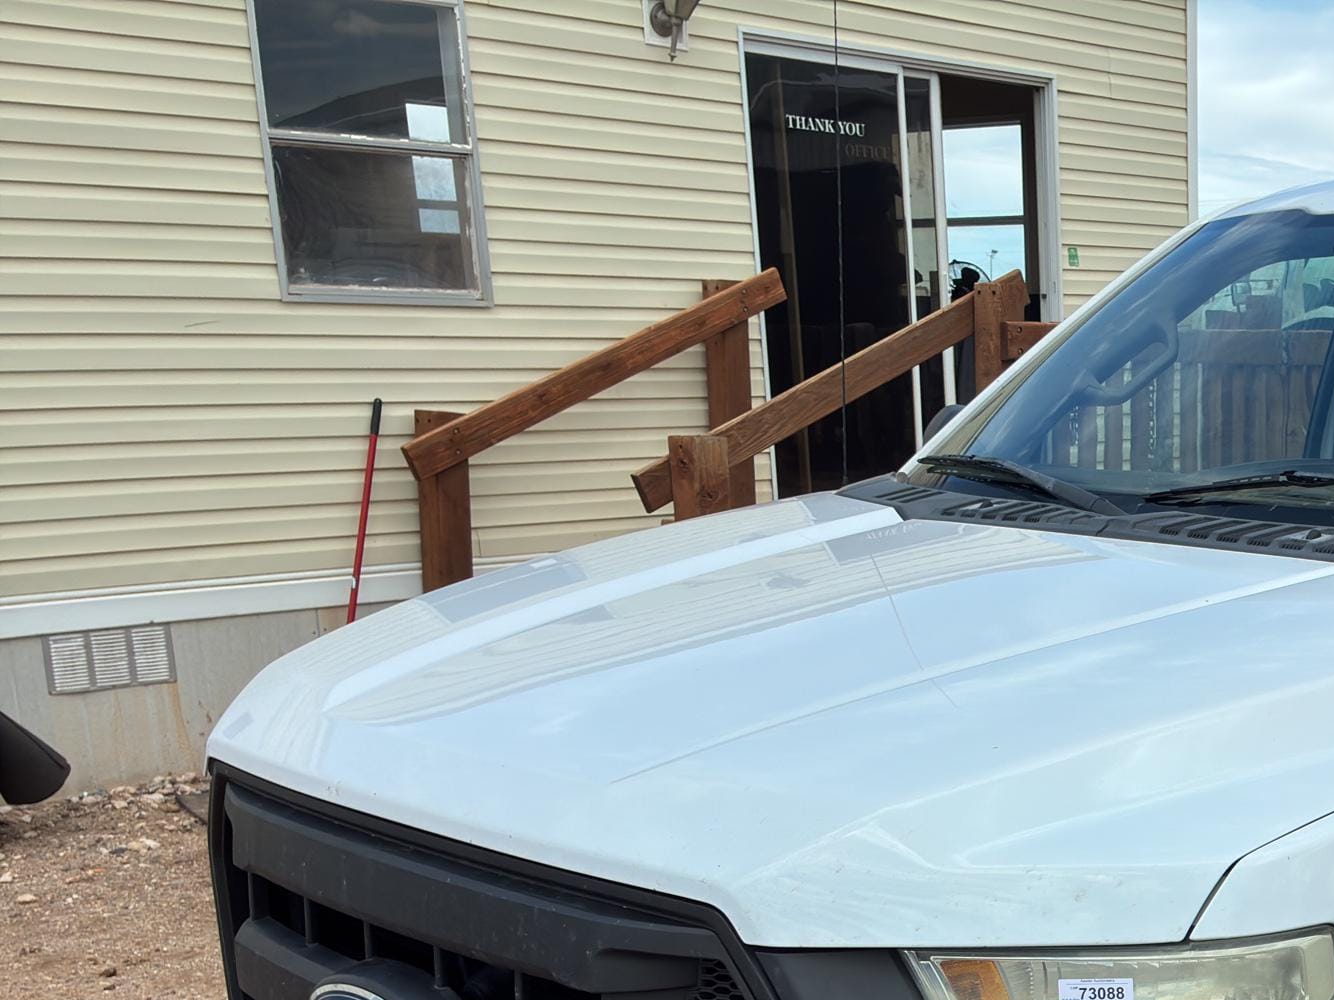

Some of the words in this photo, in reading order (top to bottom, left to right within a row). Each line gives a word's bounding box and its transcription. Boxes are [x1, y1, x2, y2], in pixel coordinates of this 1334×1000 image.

[786, 114, 835, 134] THANK
[837, 121, 866, 137] YOU
[1079, 986, 1124, 1000] 73088
